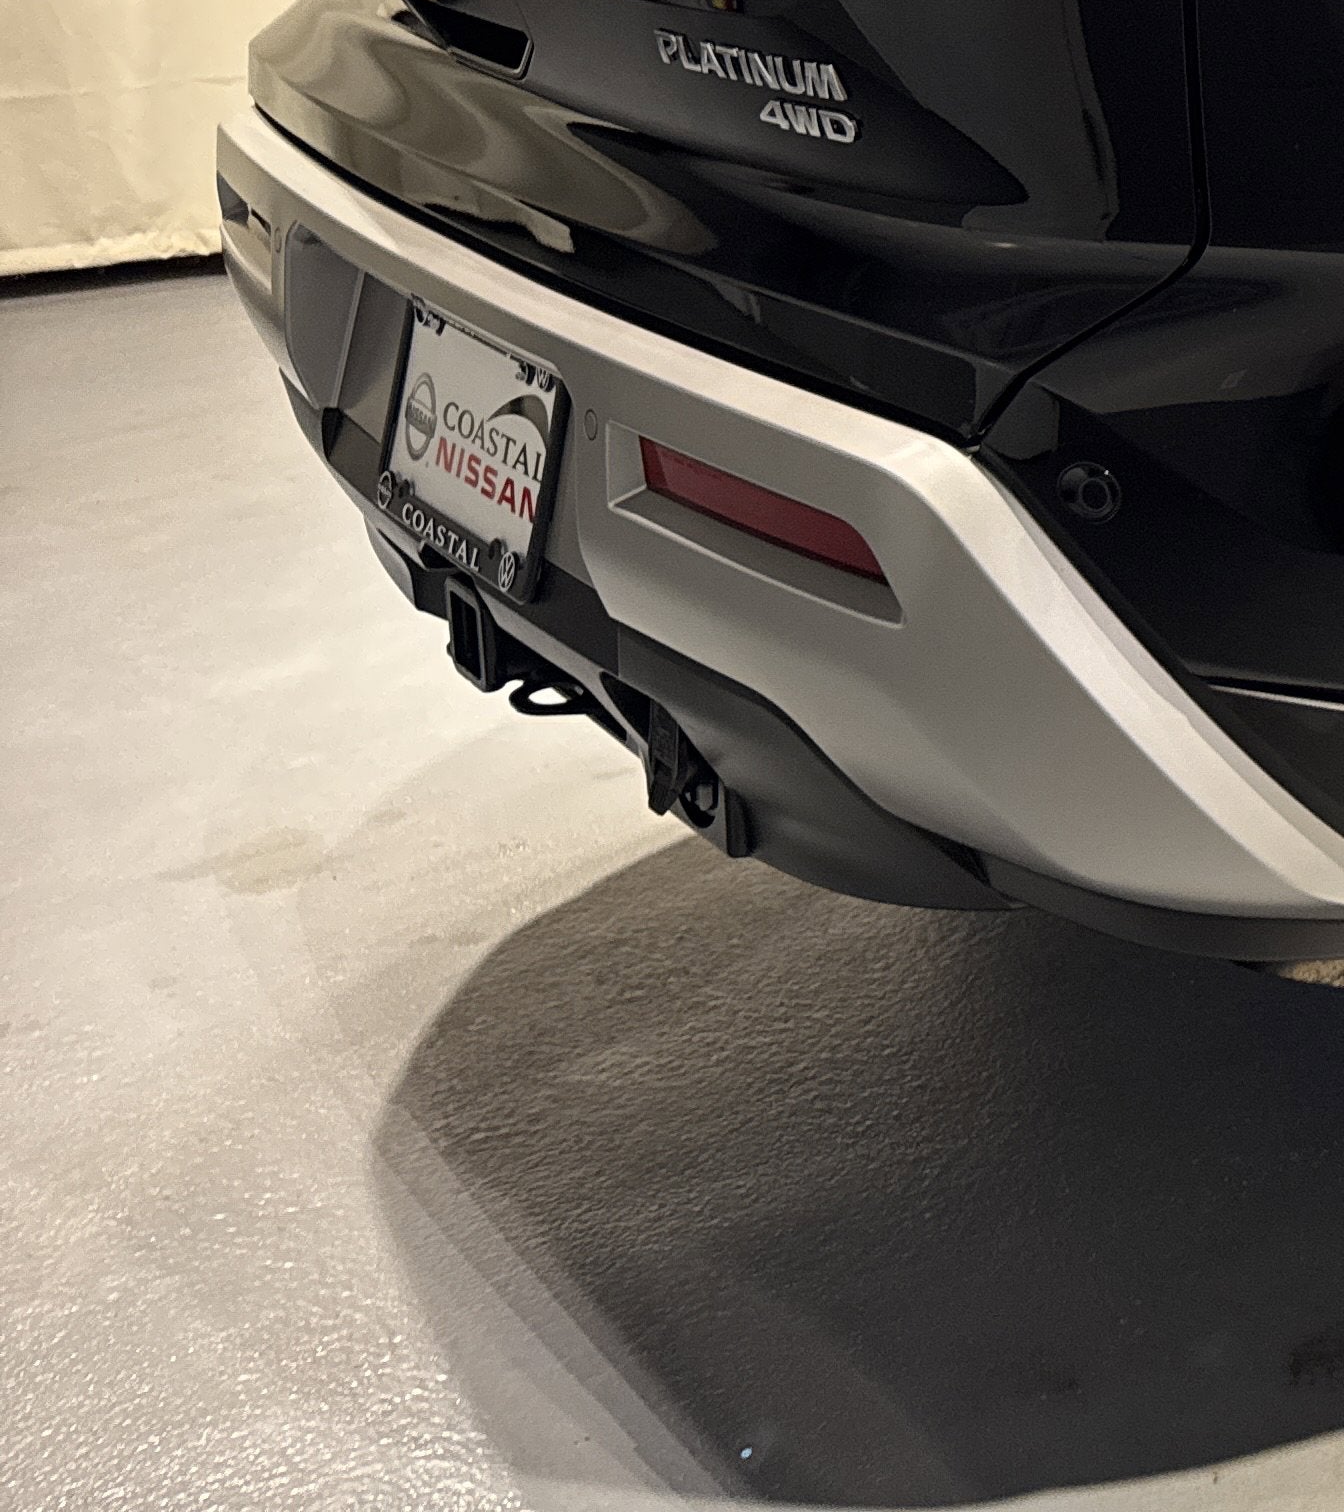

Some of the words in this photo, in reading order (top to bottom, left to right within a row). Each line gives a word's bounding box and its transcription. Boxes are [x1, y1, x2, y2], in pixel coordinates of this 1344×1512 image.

[653, 28, 848, 102] PLATINUM
[759, 99, 858, 144] 4WD
[443, 402, 543, 483] COASTAL
[402, 503, 480, 573] COASTAL
